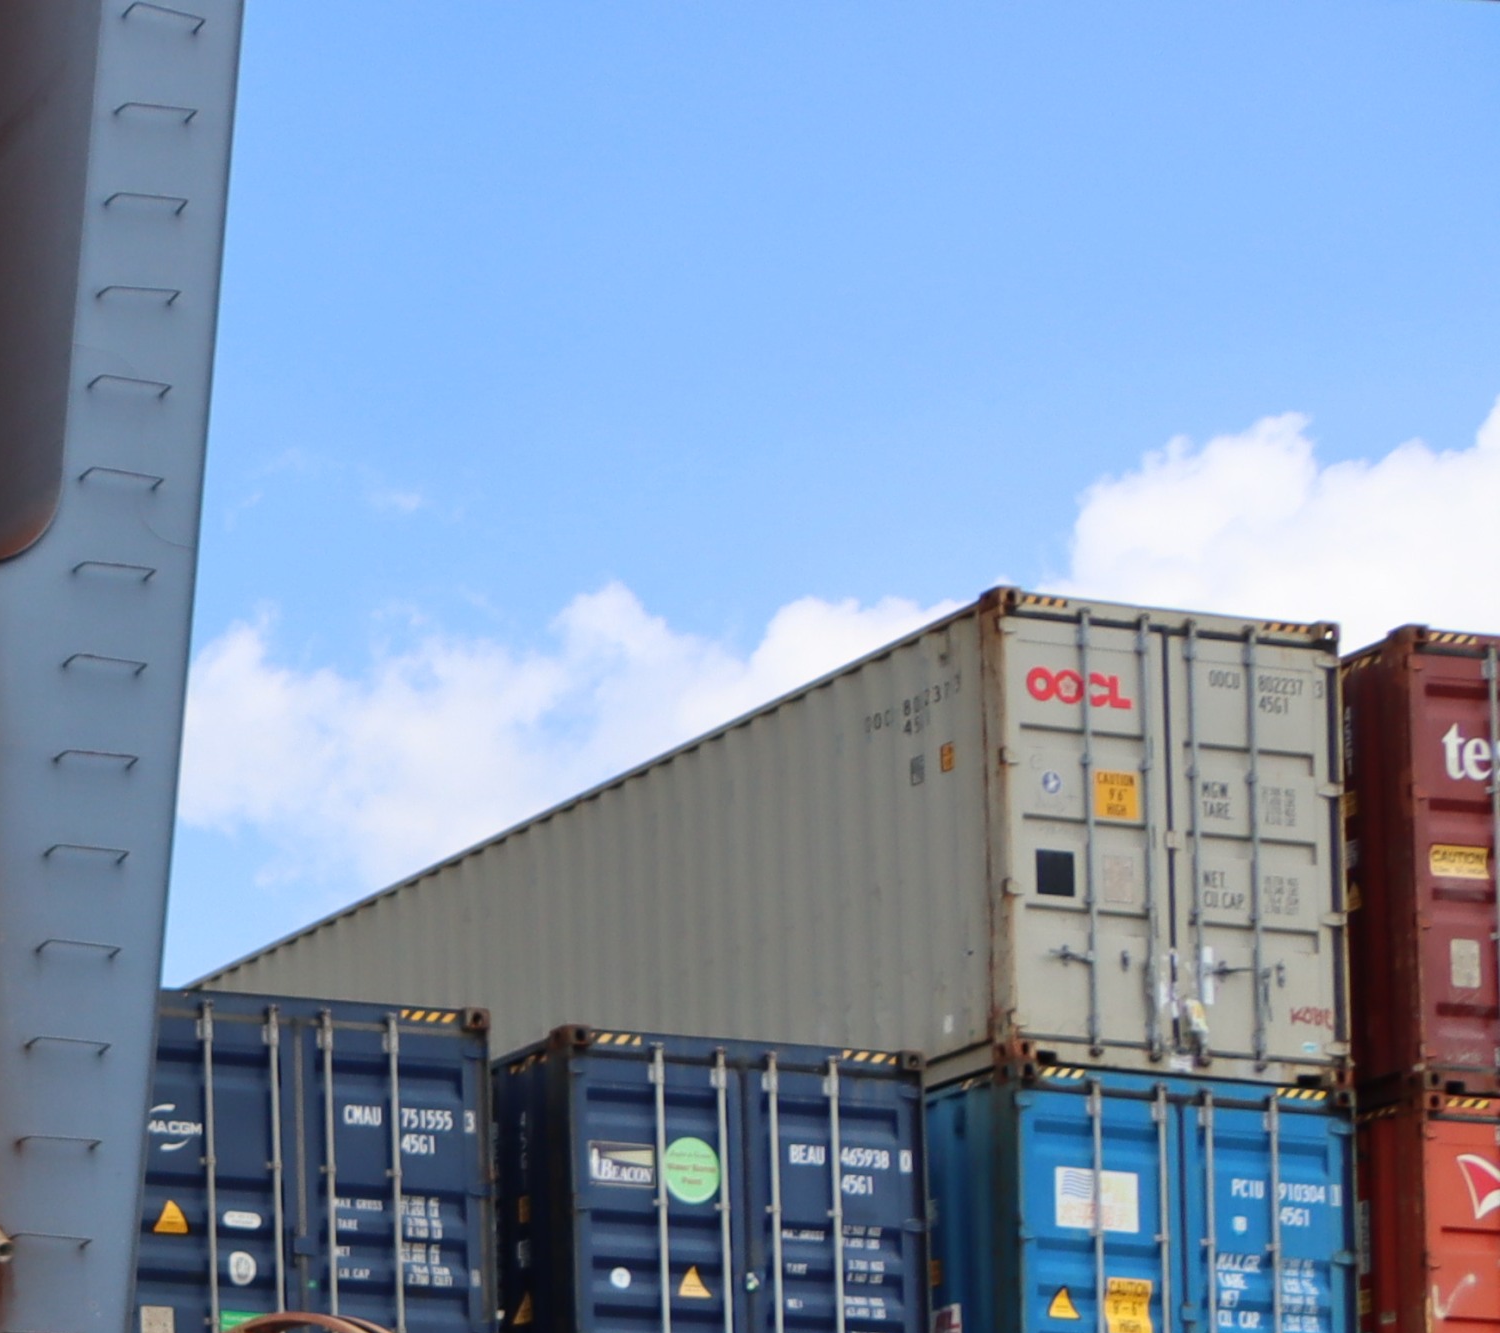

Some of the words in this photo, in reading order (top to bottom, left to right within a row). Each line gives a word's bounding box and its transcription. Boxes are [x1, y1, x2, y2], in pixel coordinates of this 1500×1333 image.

[1209, 670, 1241, 690] OOCU
[1258, 676, 1303, 697] 802237
[1258, 697, 1289, 714] 45G1
[1441, 723, 1500, 780] te
[1097, 772, 1135, 788] CAUTION
[1106, 801, 1127, 816] HIGH
[344, 1105, 382, 1126] CMAU
[401, 1108, 453, 1131] 751555
[465, 1110, 476, 1133] 3
[401, 1133, 436, 1154] 45G1
[789, 1144, 825, 1164] BEAU
[840, 1147, 889, 1169] 465938
[600, 1158, 652, 1183] BEACON
[841, 1174, 873, 1195] 45G1
[1231, 1178, 1265, 1199] PCIU
[1278, 1182, 1325, 1203] 910304
[1279, 1206, 1310, 1227] 45G1
